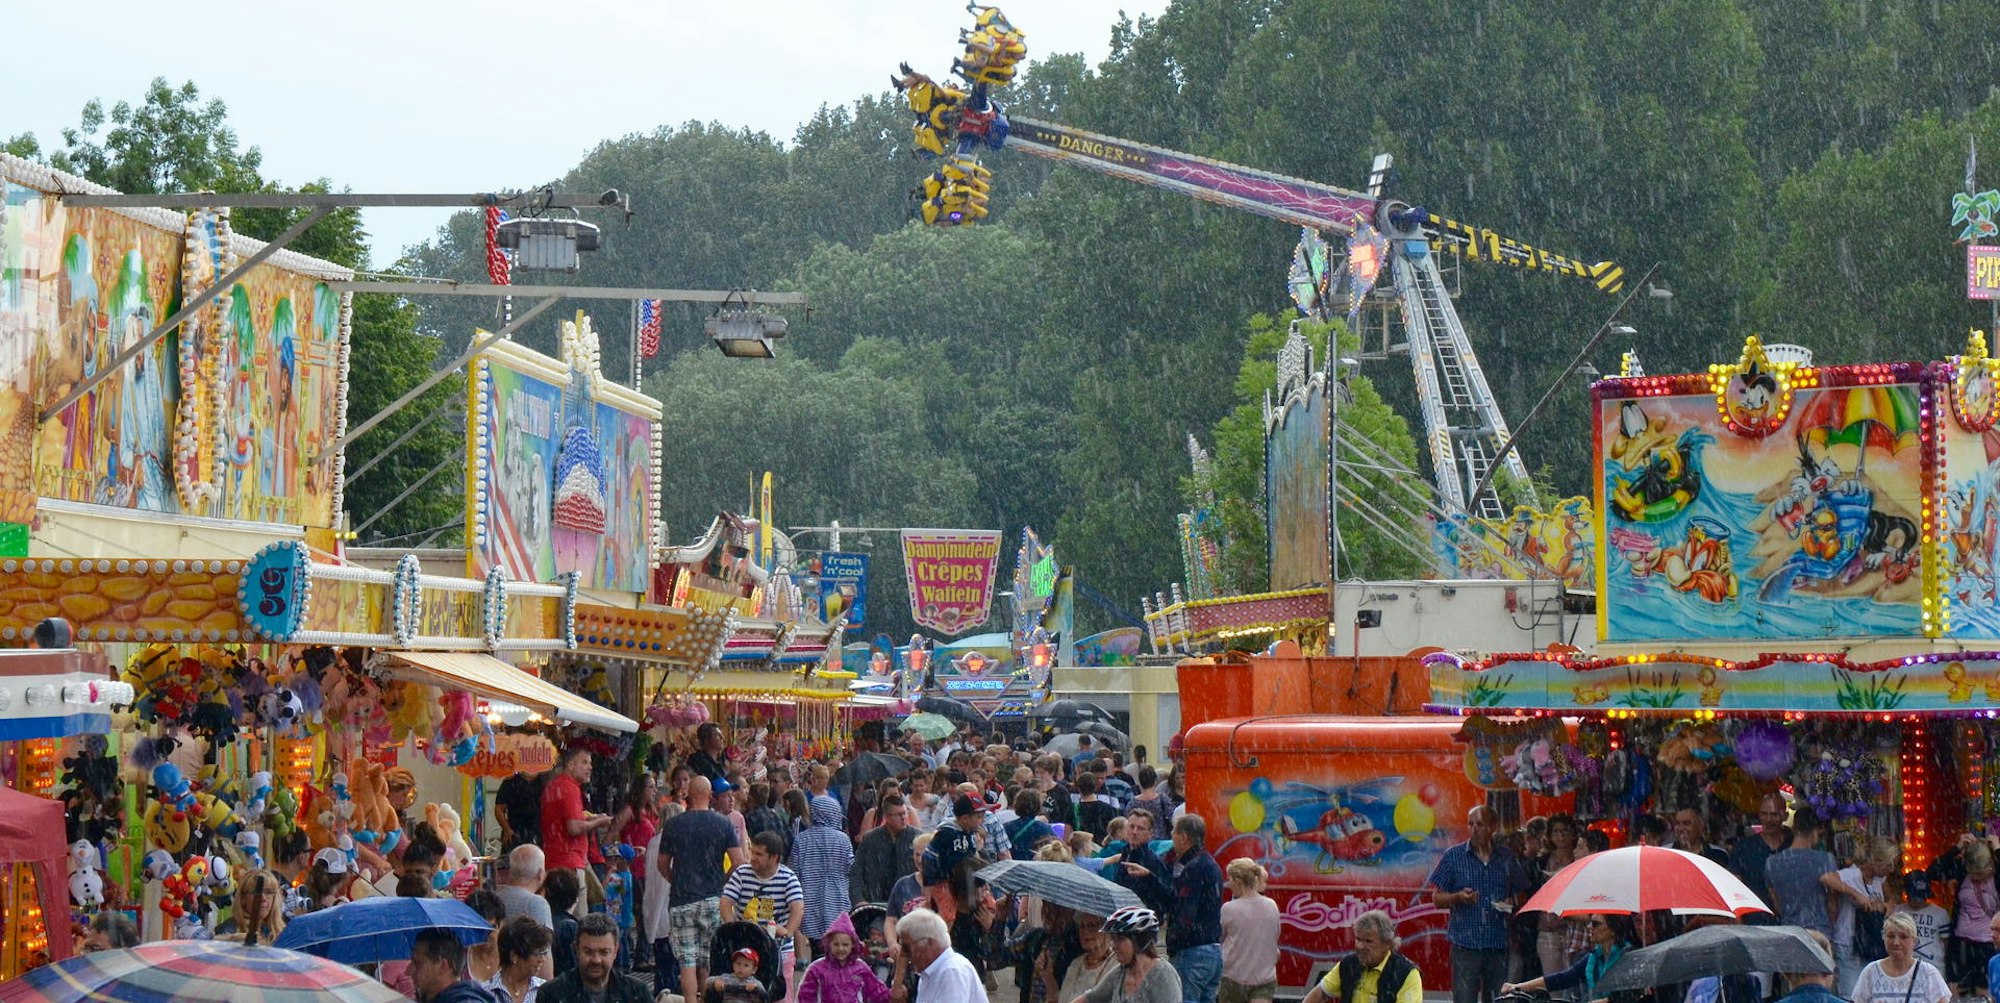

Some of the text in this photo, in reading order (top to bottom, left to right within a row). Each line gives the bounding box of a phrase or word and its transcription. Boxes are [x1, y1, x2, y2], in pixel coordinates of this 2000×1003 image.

[1059, 134, 1124, 162] DANGER
[828, 556, 862, 566] fresh
[918, 560, 983, 584] Crêpes
[921, 586, 980, 602] Waffeln
